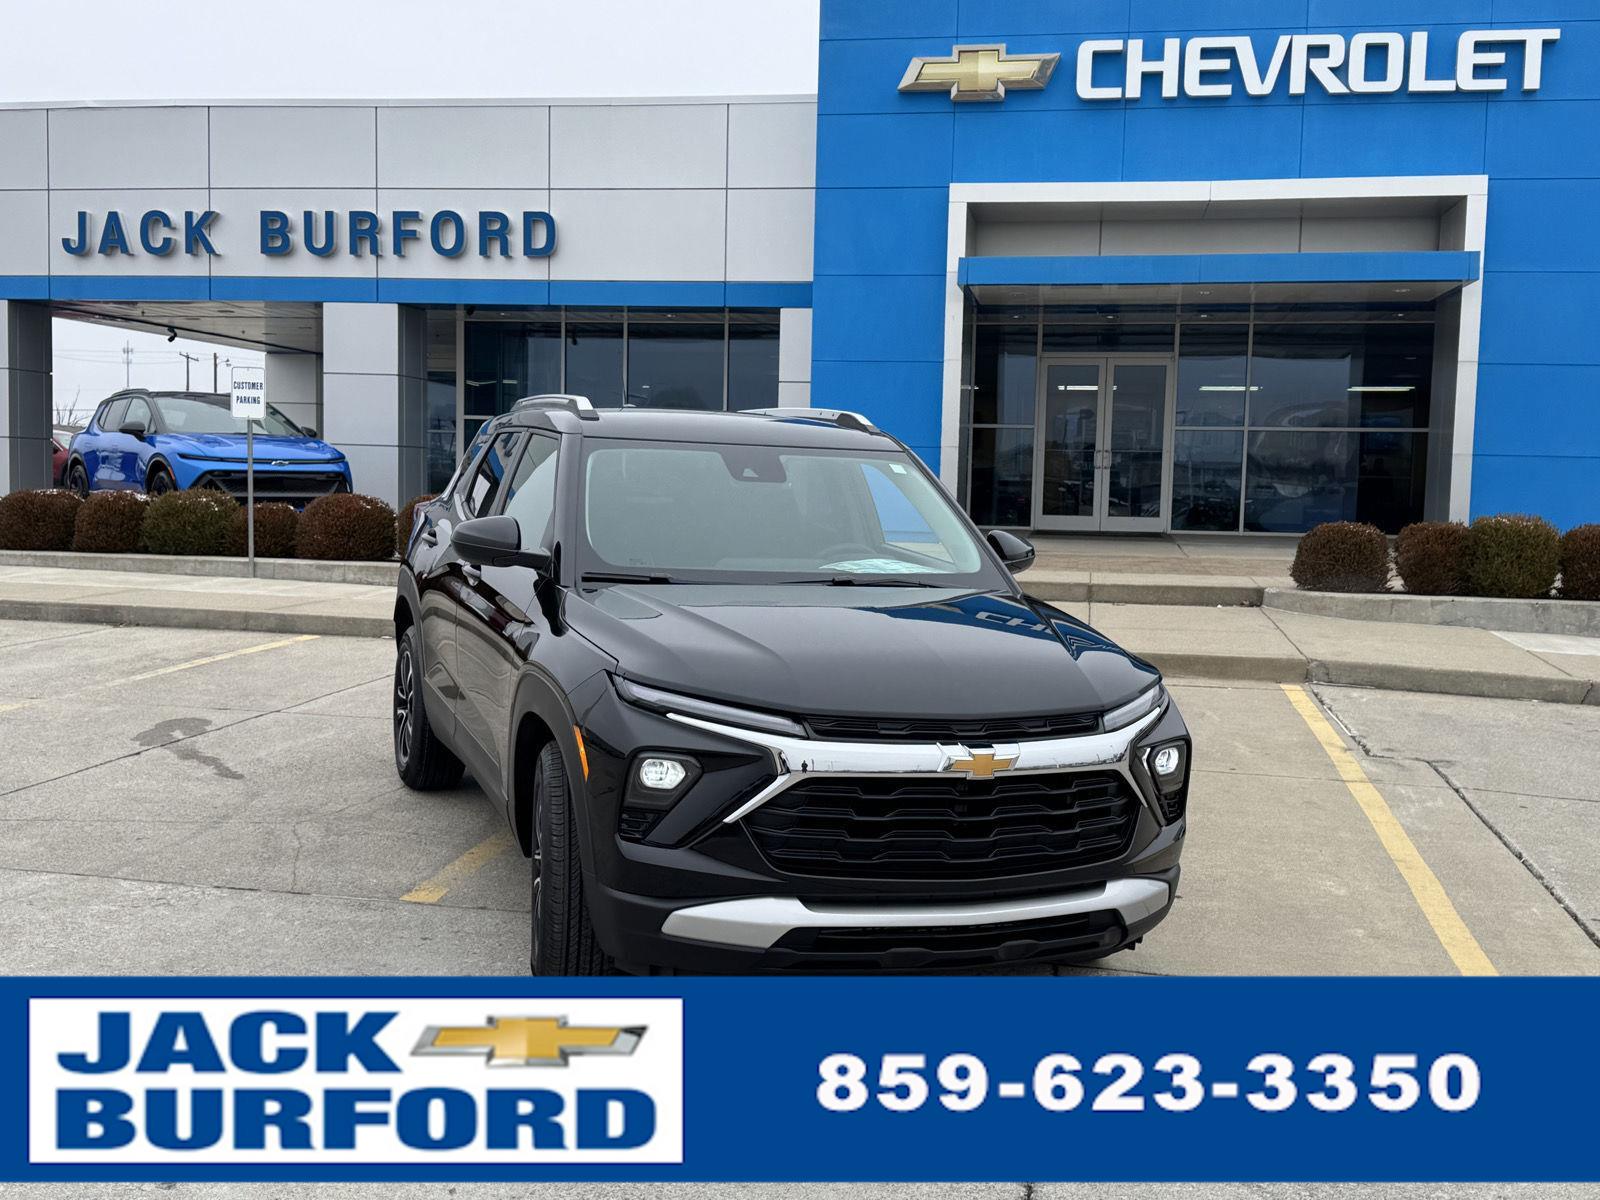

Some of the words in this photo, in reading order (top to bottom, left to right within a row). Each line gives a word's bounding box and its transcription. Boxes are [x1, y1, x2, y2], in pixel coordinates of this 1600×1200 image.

[1076, 28, 1561, 101] CHEVROLET
[62, 209, 219, 256] JACK
[260, 210, 559, 258] BURFORD
[233, 381, 264, 390] CUSTOMER
[236, 395, 261, 404] PARKING
